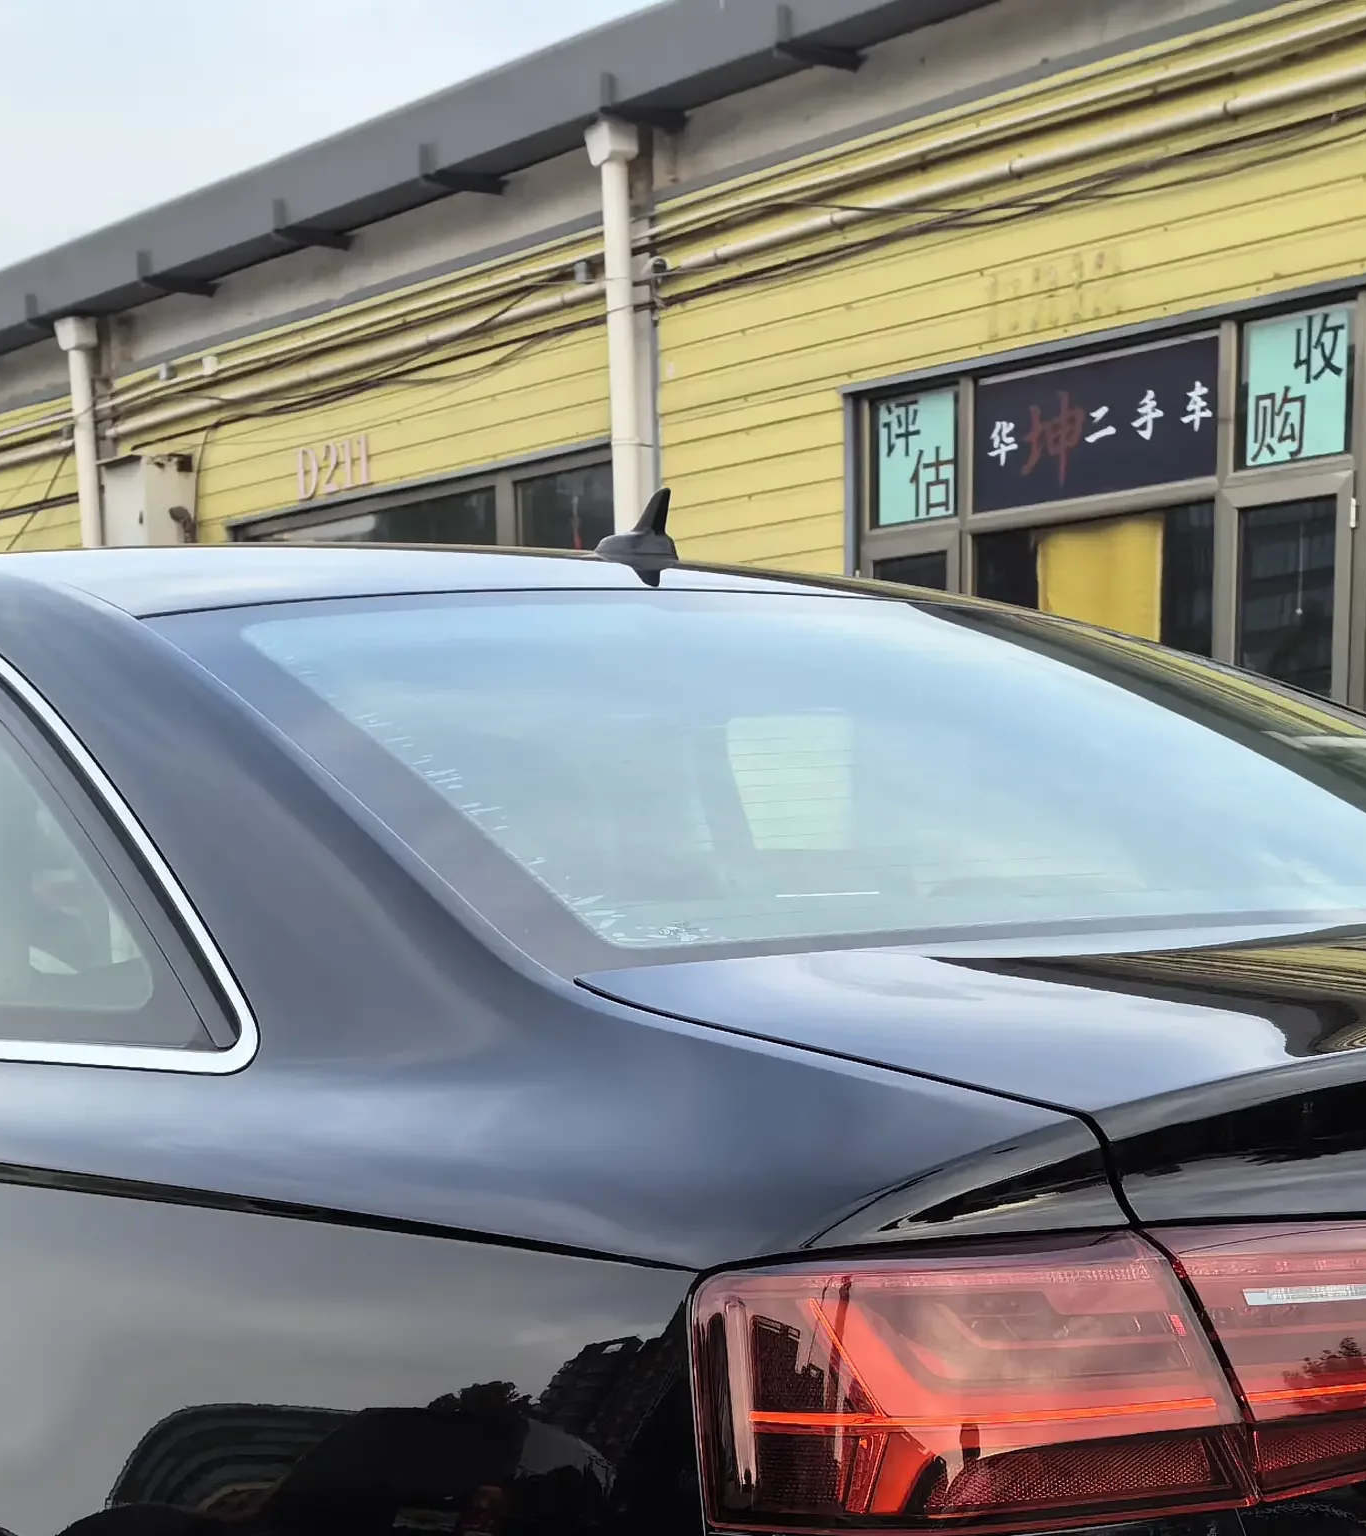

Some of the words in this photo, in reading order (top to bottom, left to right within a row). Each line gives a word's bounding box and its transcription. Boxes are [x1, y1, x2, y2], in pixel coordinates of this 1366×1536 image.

[297, 434, 370, 502] D211
[882, 399, 954, 517] 评估
[987, 380, 1213, 488] 华坤二手车
